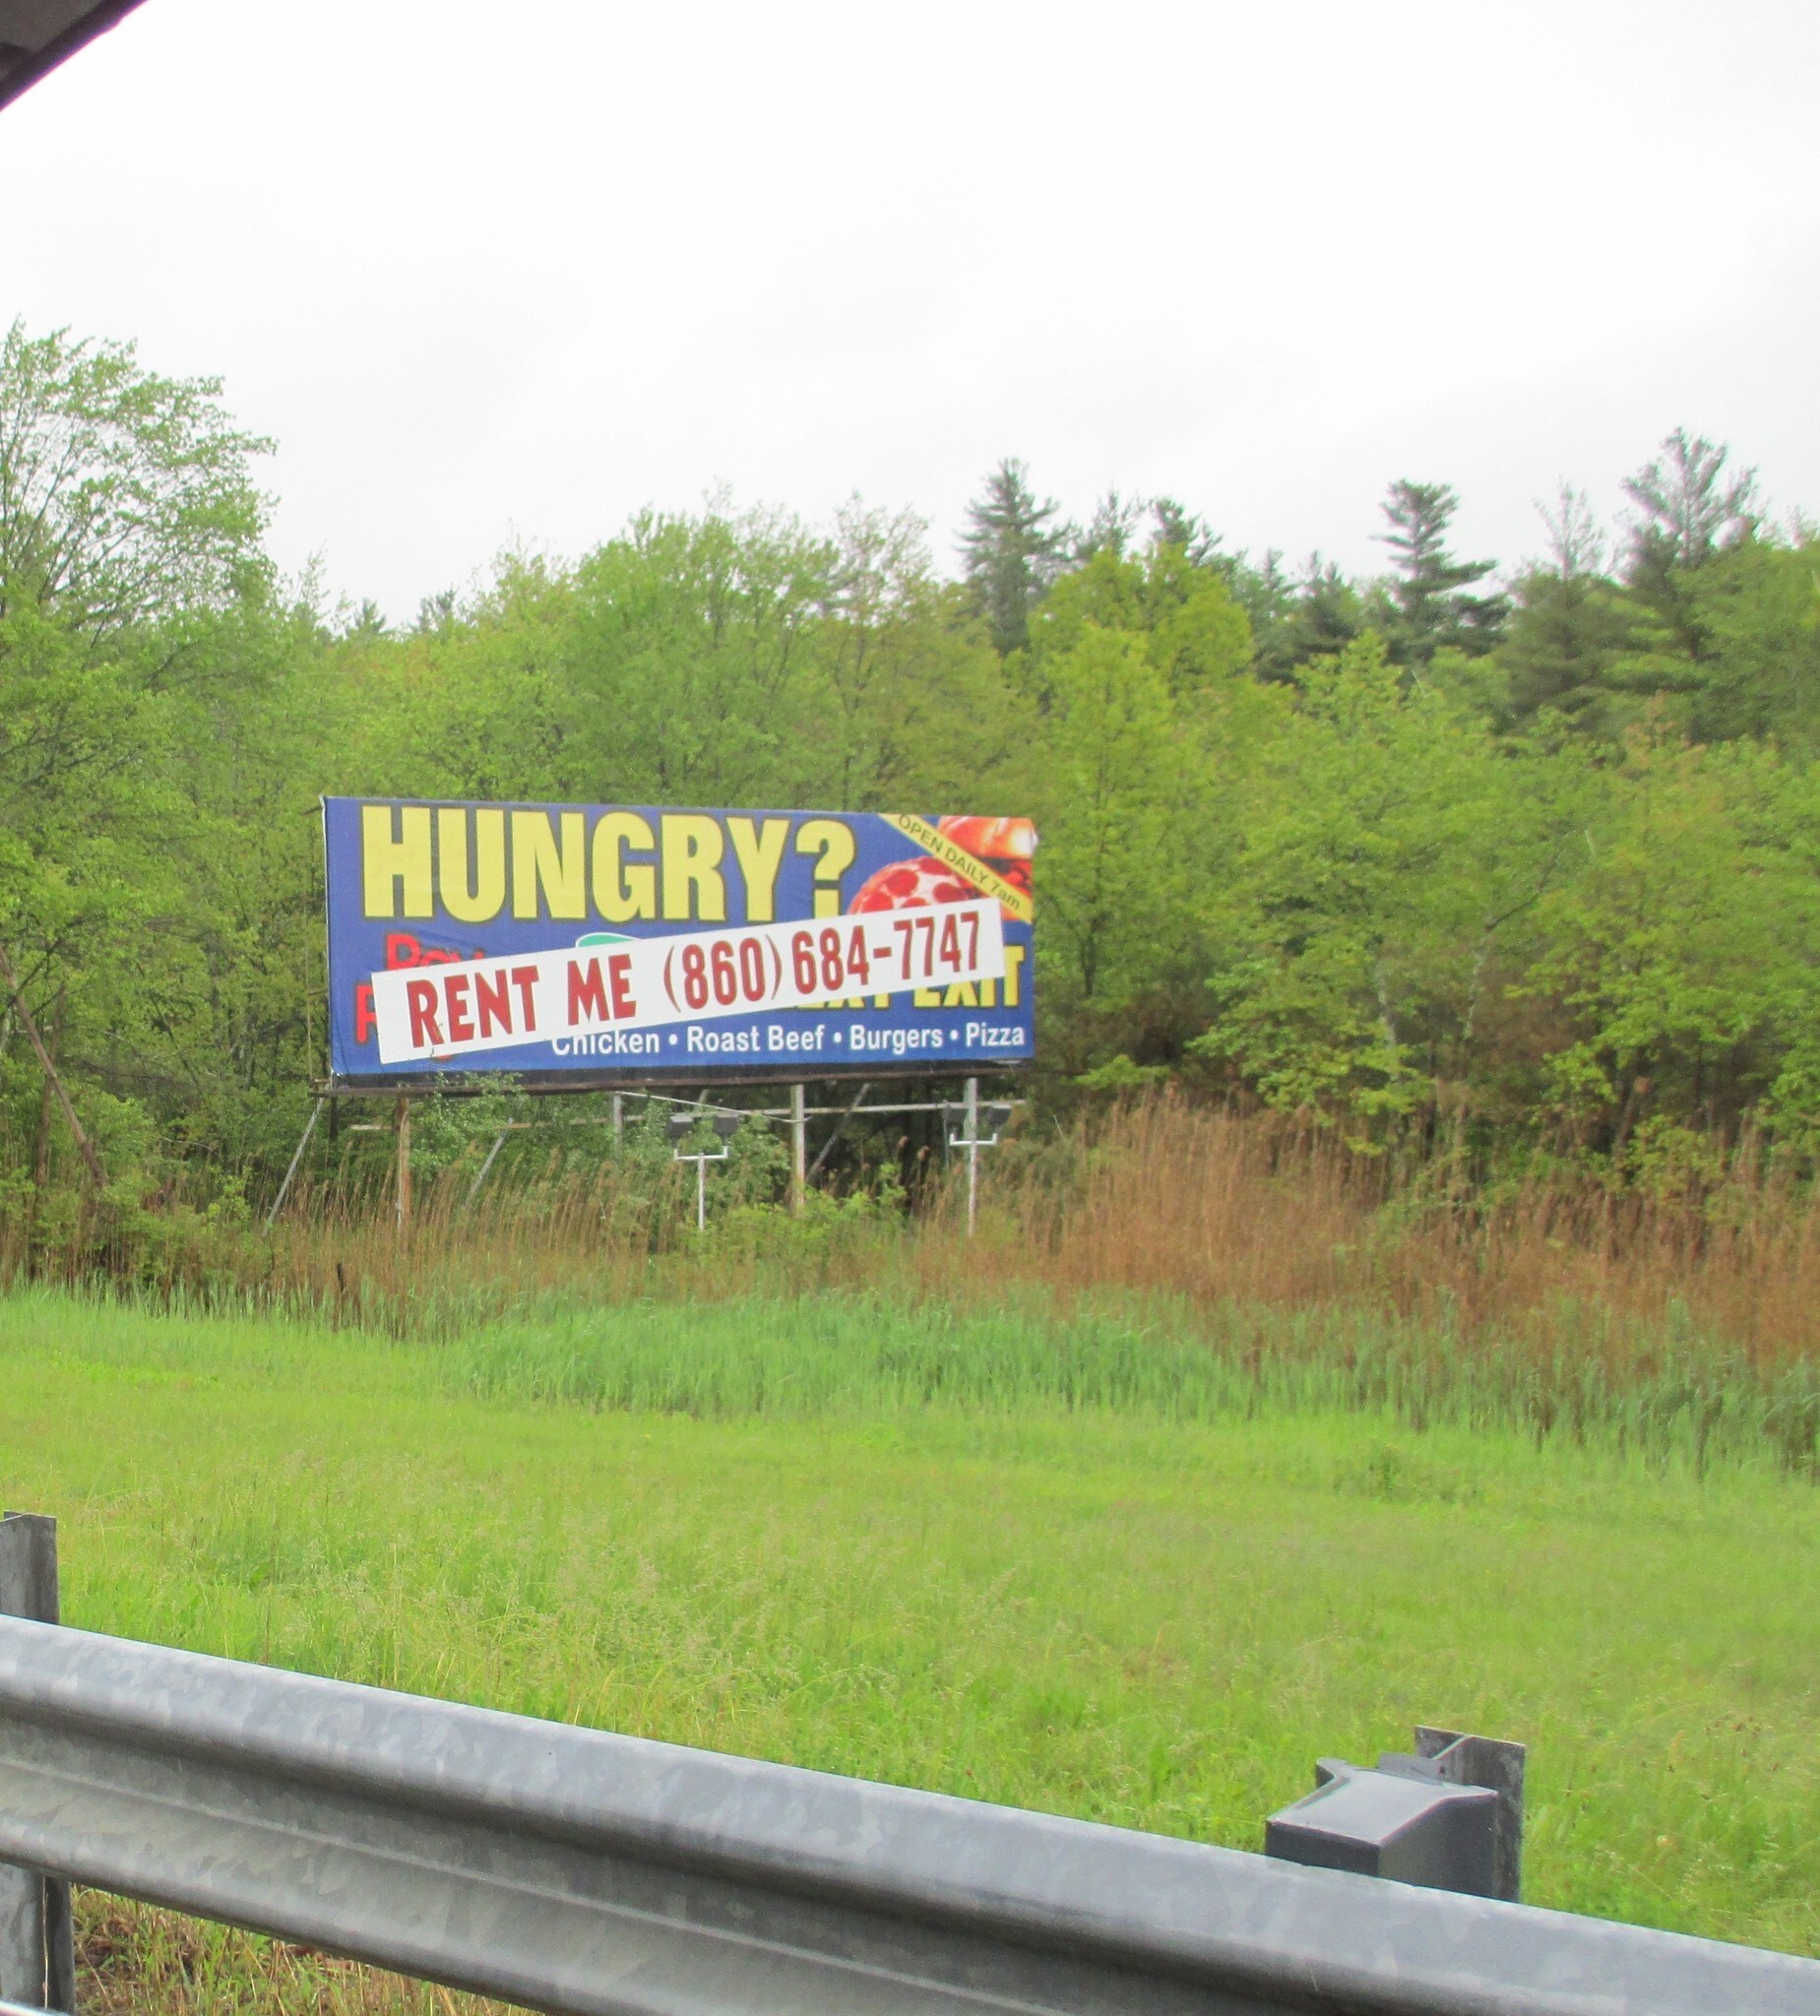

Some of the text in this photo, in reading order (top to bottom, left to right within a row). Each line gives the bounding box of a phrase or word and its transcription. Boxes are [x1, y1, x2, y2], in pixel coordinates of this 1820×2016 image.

[361, 805, 855, 922] HUNGRY?
[898, 812, 1021, 910] OPEN DAILY 7am
[406, 965, 539, 1048] RENT
[567, 953, 637, 1026] ME
[551, 1022, 1026, 1056] Chicken Roast Beef Burgers Pizza
